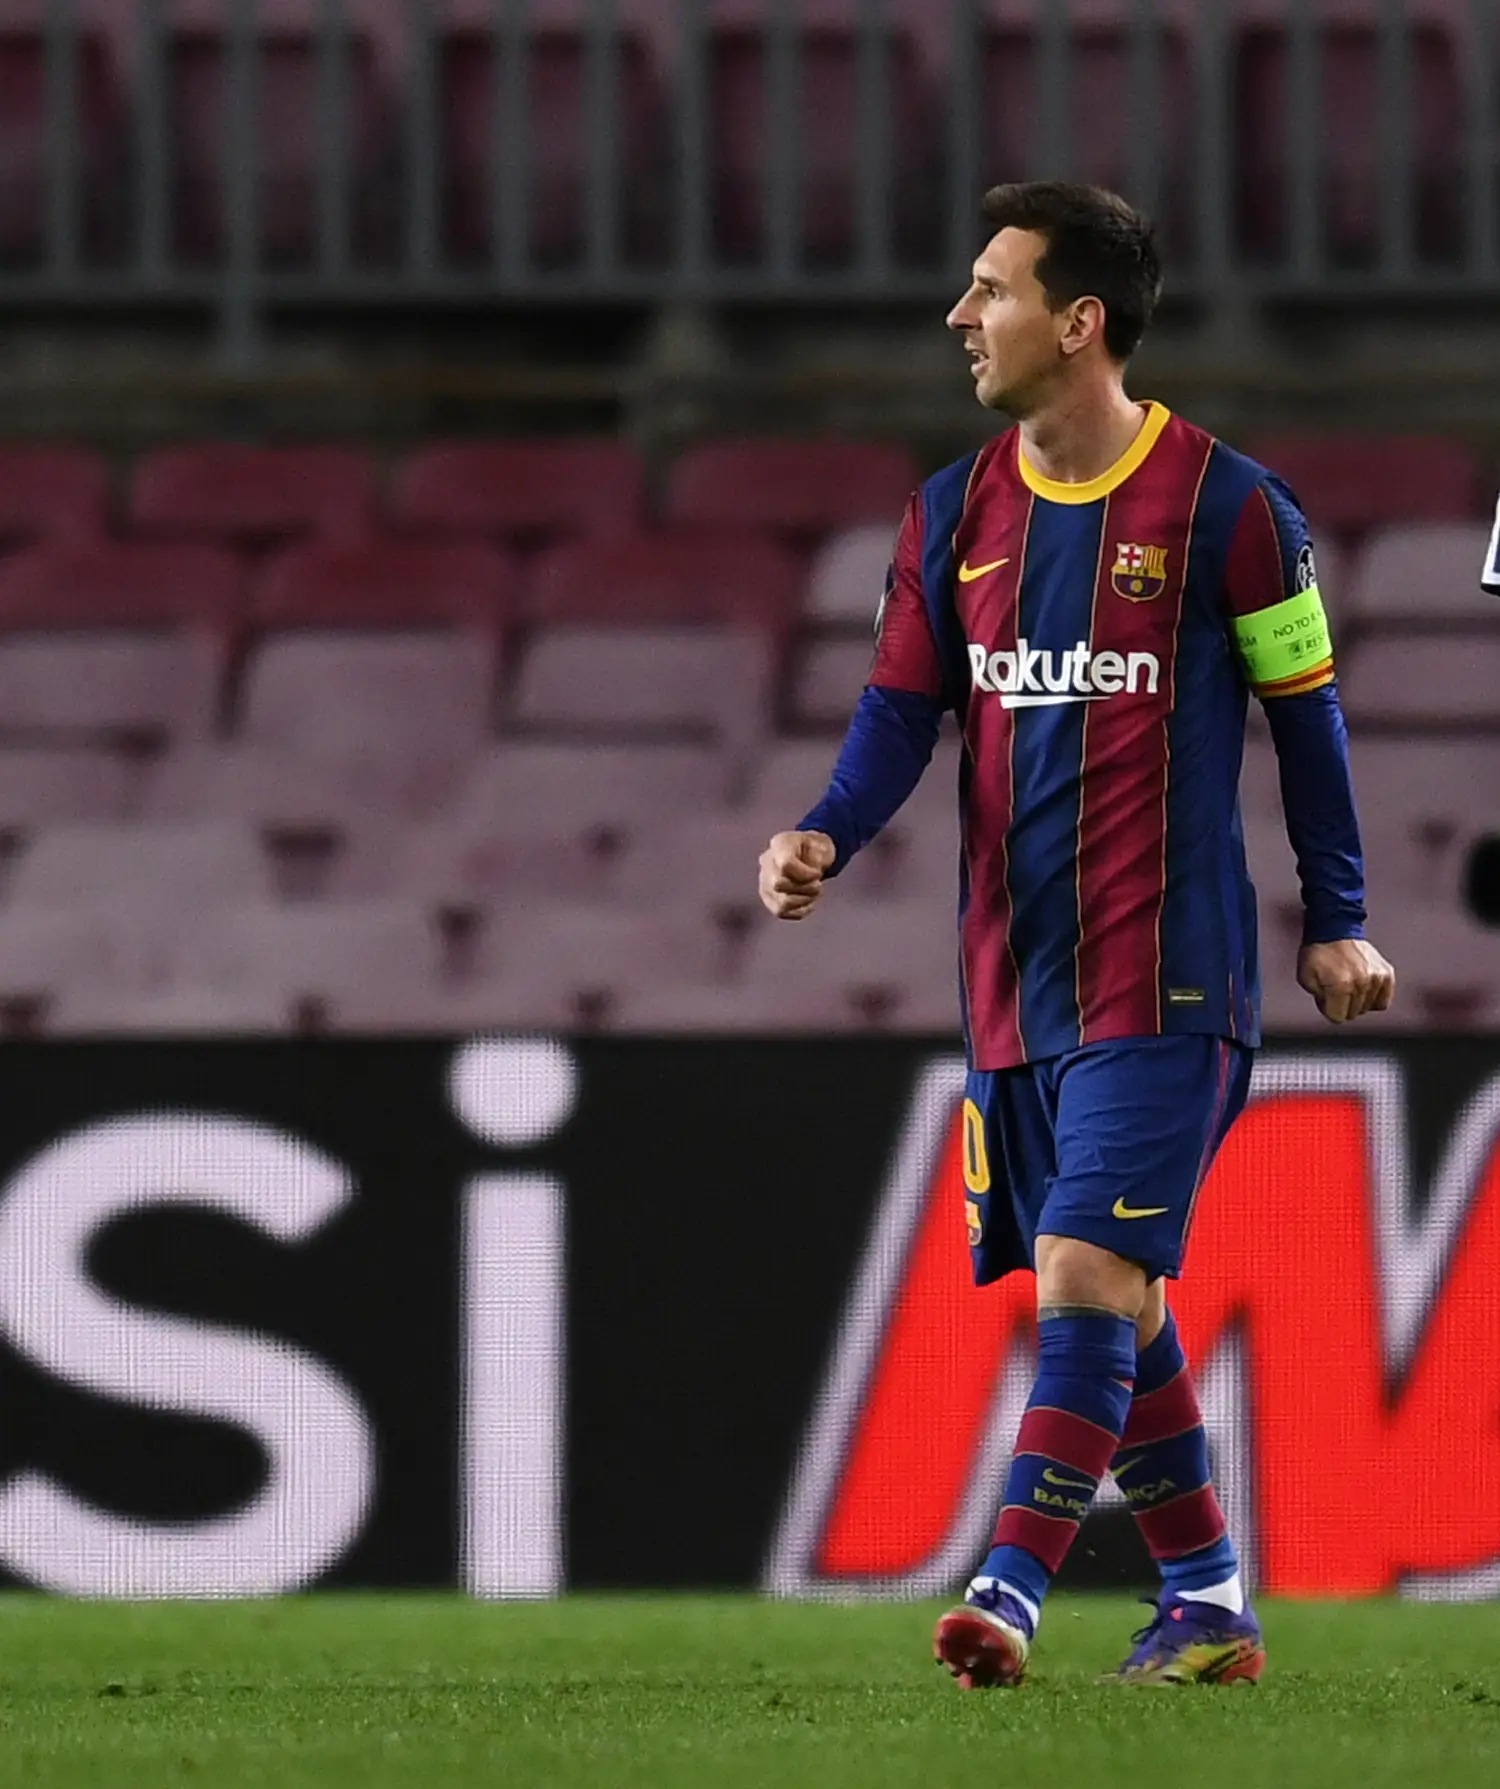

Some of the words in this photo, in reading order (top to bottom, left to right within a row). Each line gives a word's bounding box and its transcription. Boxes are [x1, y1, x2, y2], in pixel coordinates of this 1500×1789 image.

[1272, 623, 1294, 640] NO
[1295, 616, 1310, 630] TO
[967, 638, 1160, 694] Rakuten
